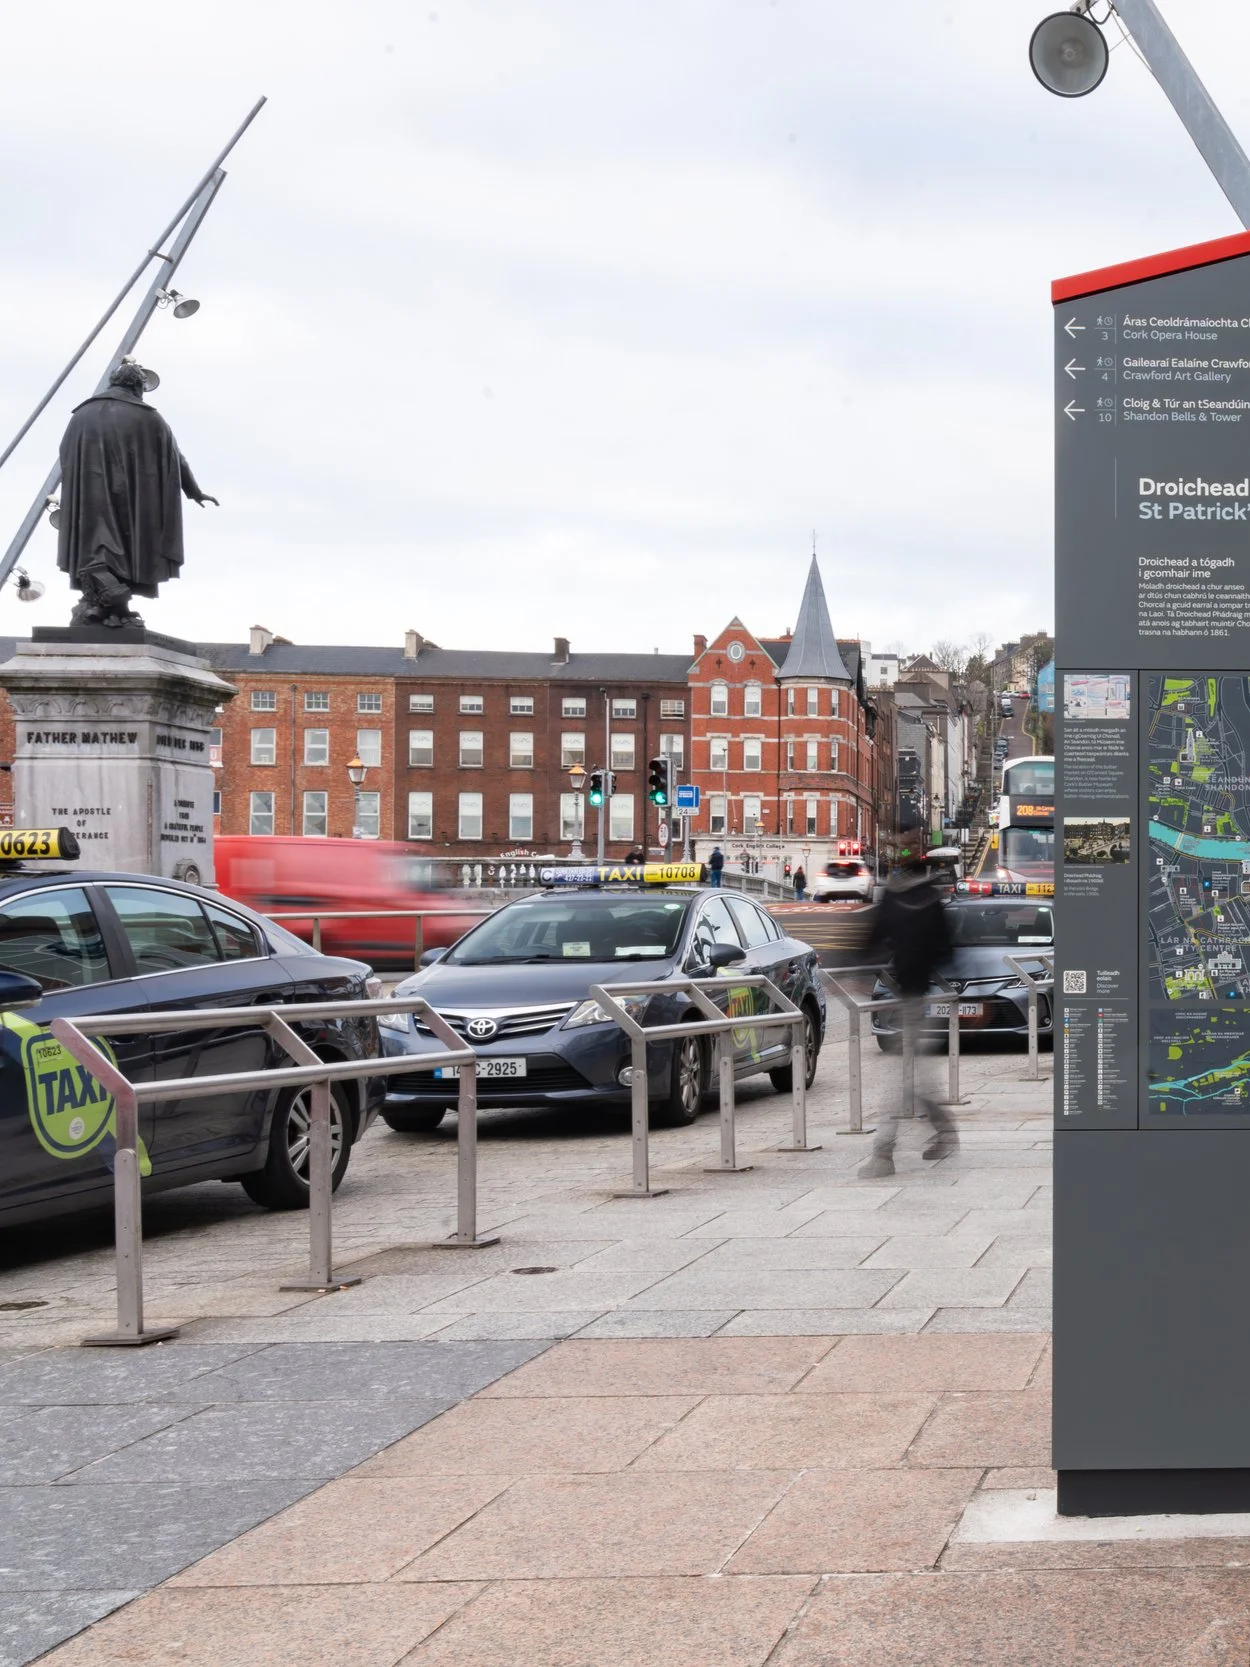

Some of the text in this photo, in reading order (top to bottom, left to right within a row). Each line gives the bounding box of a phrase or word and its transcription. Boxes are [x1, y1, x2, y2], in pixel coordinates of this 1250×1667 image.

[1123, 315, 1147, 326] Áras
[1150, 317, 1238, 328] Ceoldrámaíochta
[1102, 332, 1108, 340] 3
[1123, 330, 1218, 341] Cork Opera House
[1123, 358, 1169, 367] Gailearaí
[1172, 358, 1208, 368] Ealaíne
[1101, 372, 1108, 381] 4
[1123, 371, 1231, 383] Crawford Art Gallery
[1123, 398, 1149, 410] Cloig
[1152, 400, 1160, 408] &
[1163, 399, 1180, 408] Túr
[1198, 400, 1250, 409] tSeandúin
[1099, 413, 1112, 422] 10
[1124, 411, 1241, 422] Shandon Bells & Tower
[1139, 477, 1249, 497] Droichead
[1139, 502, 1162, 520] St
[1139, 557, 1189, 566] Droichead
[1200, 558, 1234, 569] tógadh
[1144, 569, 1211, 580] gcomhair ime
[27, 732, 138, 744] FATHER MATHEW
[1016, 805, 1034, 816] 208
[0, 831, 52, 856] 0623
[597, 867, 642, 881] TAXI
[659, 866, 696, 879] 10708
[997, 884, 1021, 893] TAXI
[1161, 935, 1179, 944] LÁR
